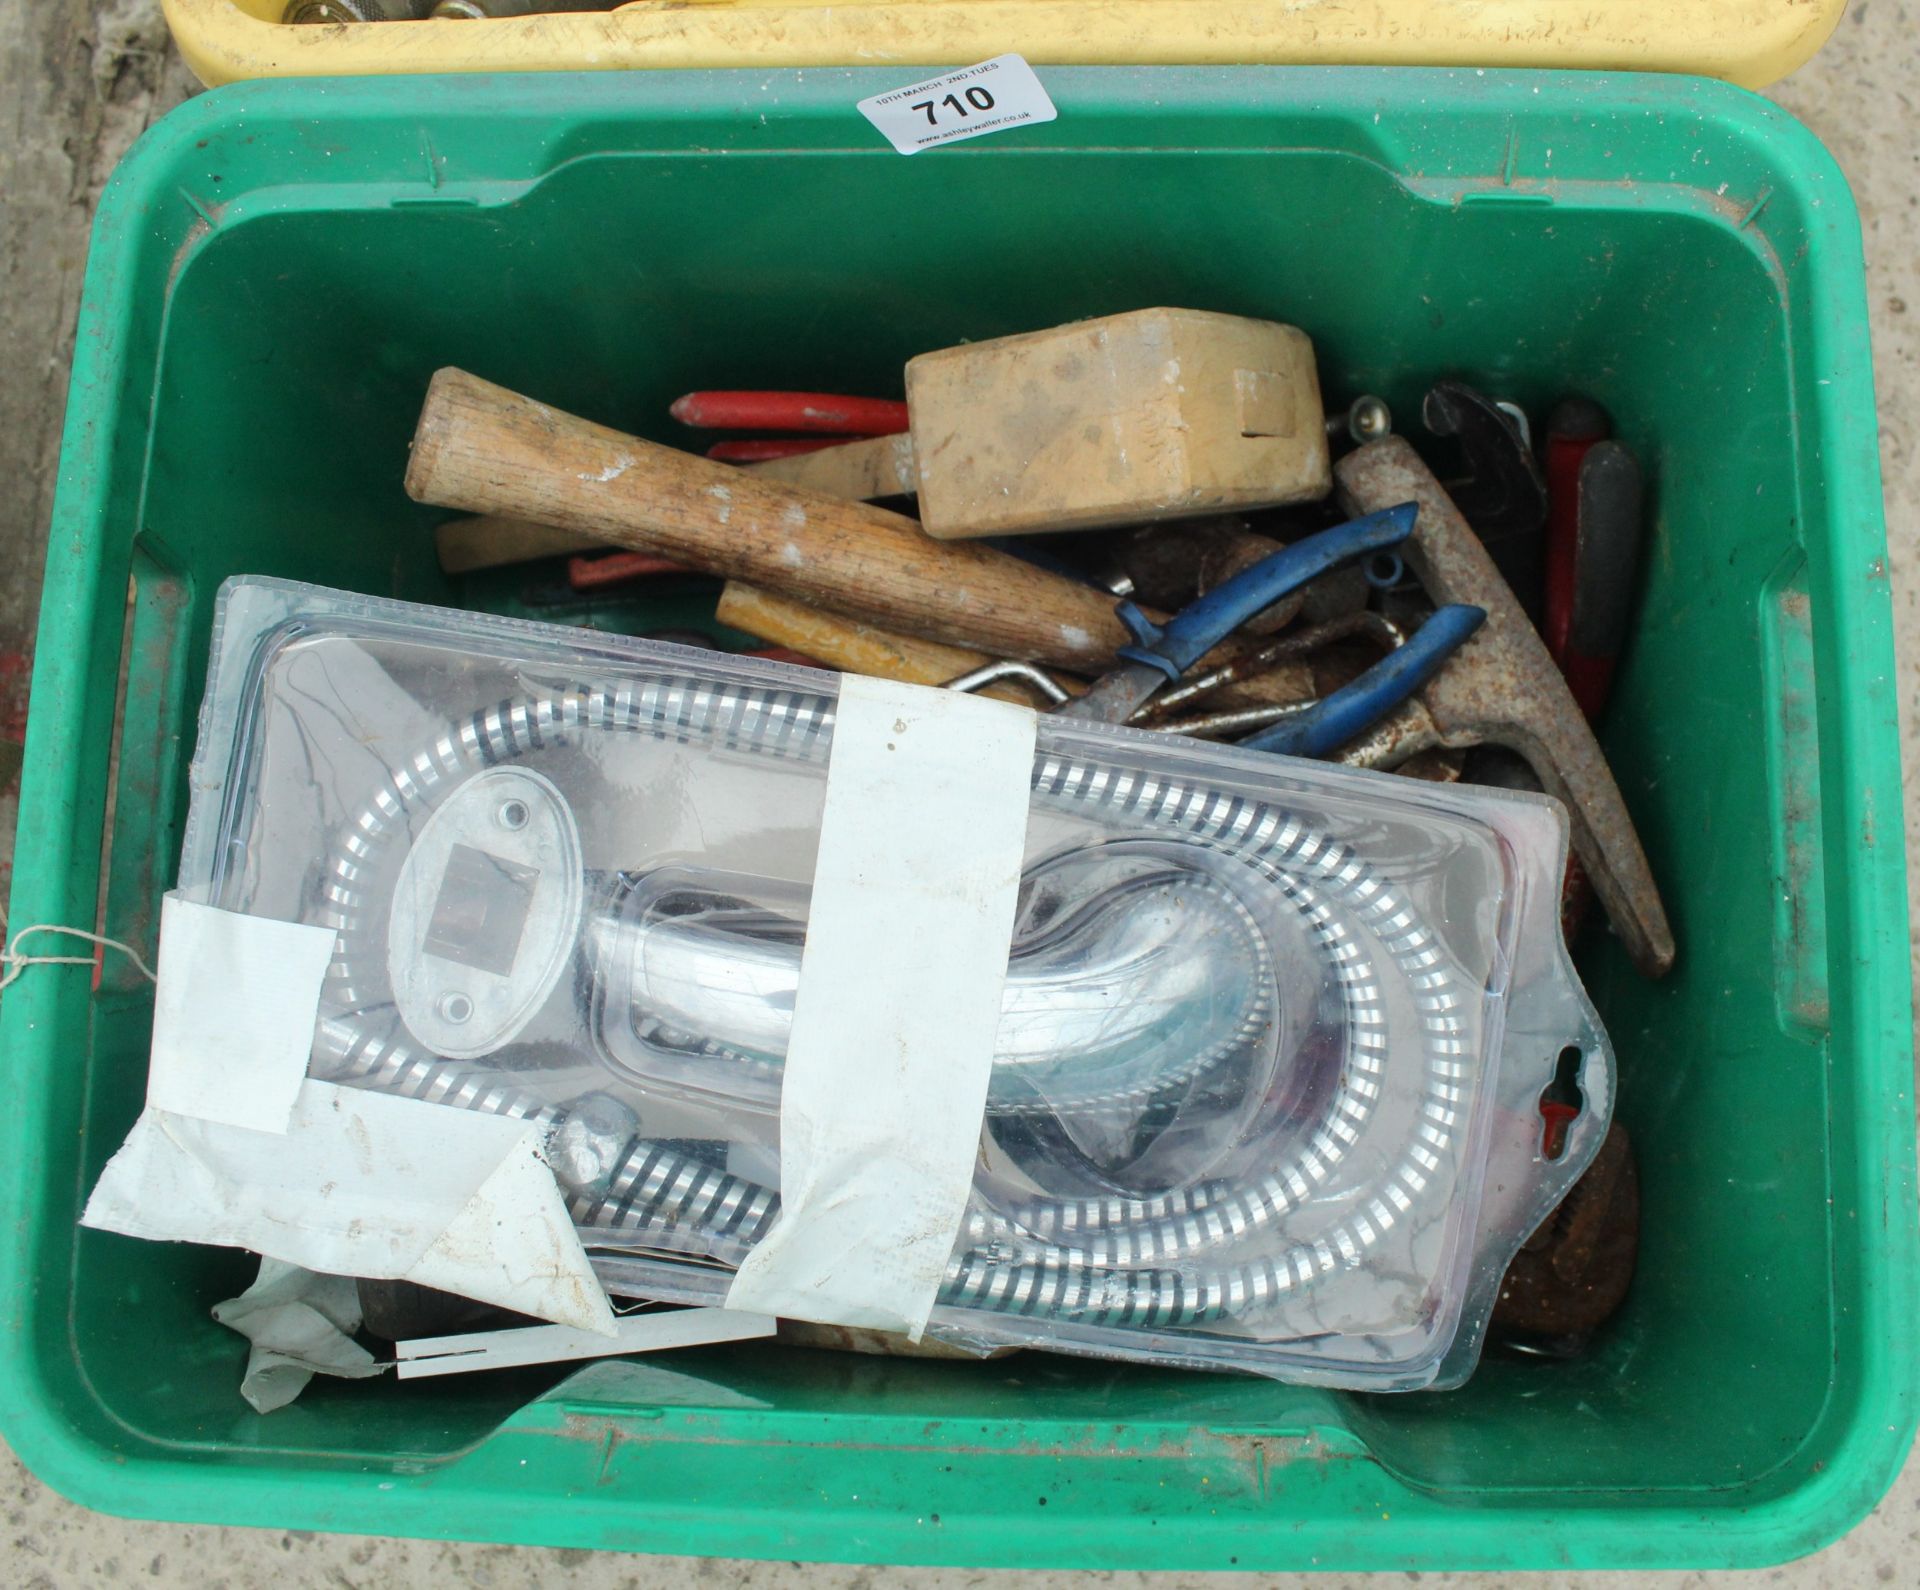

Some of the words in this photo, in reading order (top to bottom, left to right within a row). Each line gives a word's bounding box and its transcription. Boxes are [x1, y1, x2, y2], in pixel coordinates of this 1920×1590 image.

[876, 94, 902, 106] 10TH
[903, 81, 942, 97] MARCH
[911, 86, 995, 126] 710
[916, 111, 1031, 145] www.ashleywaller.co.uk
